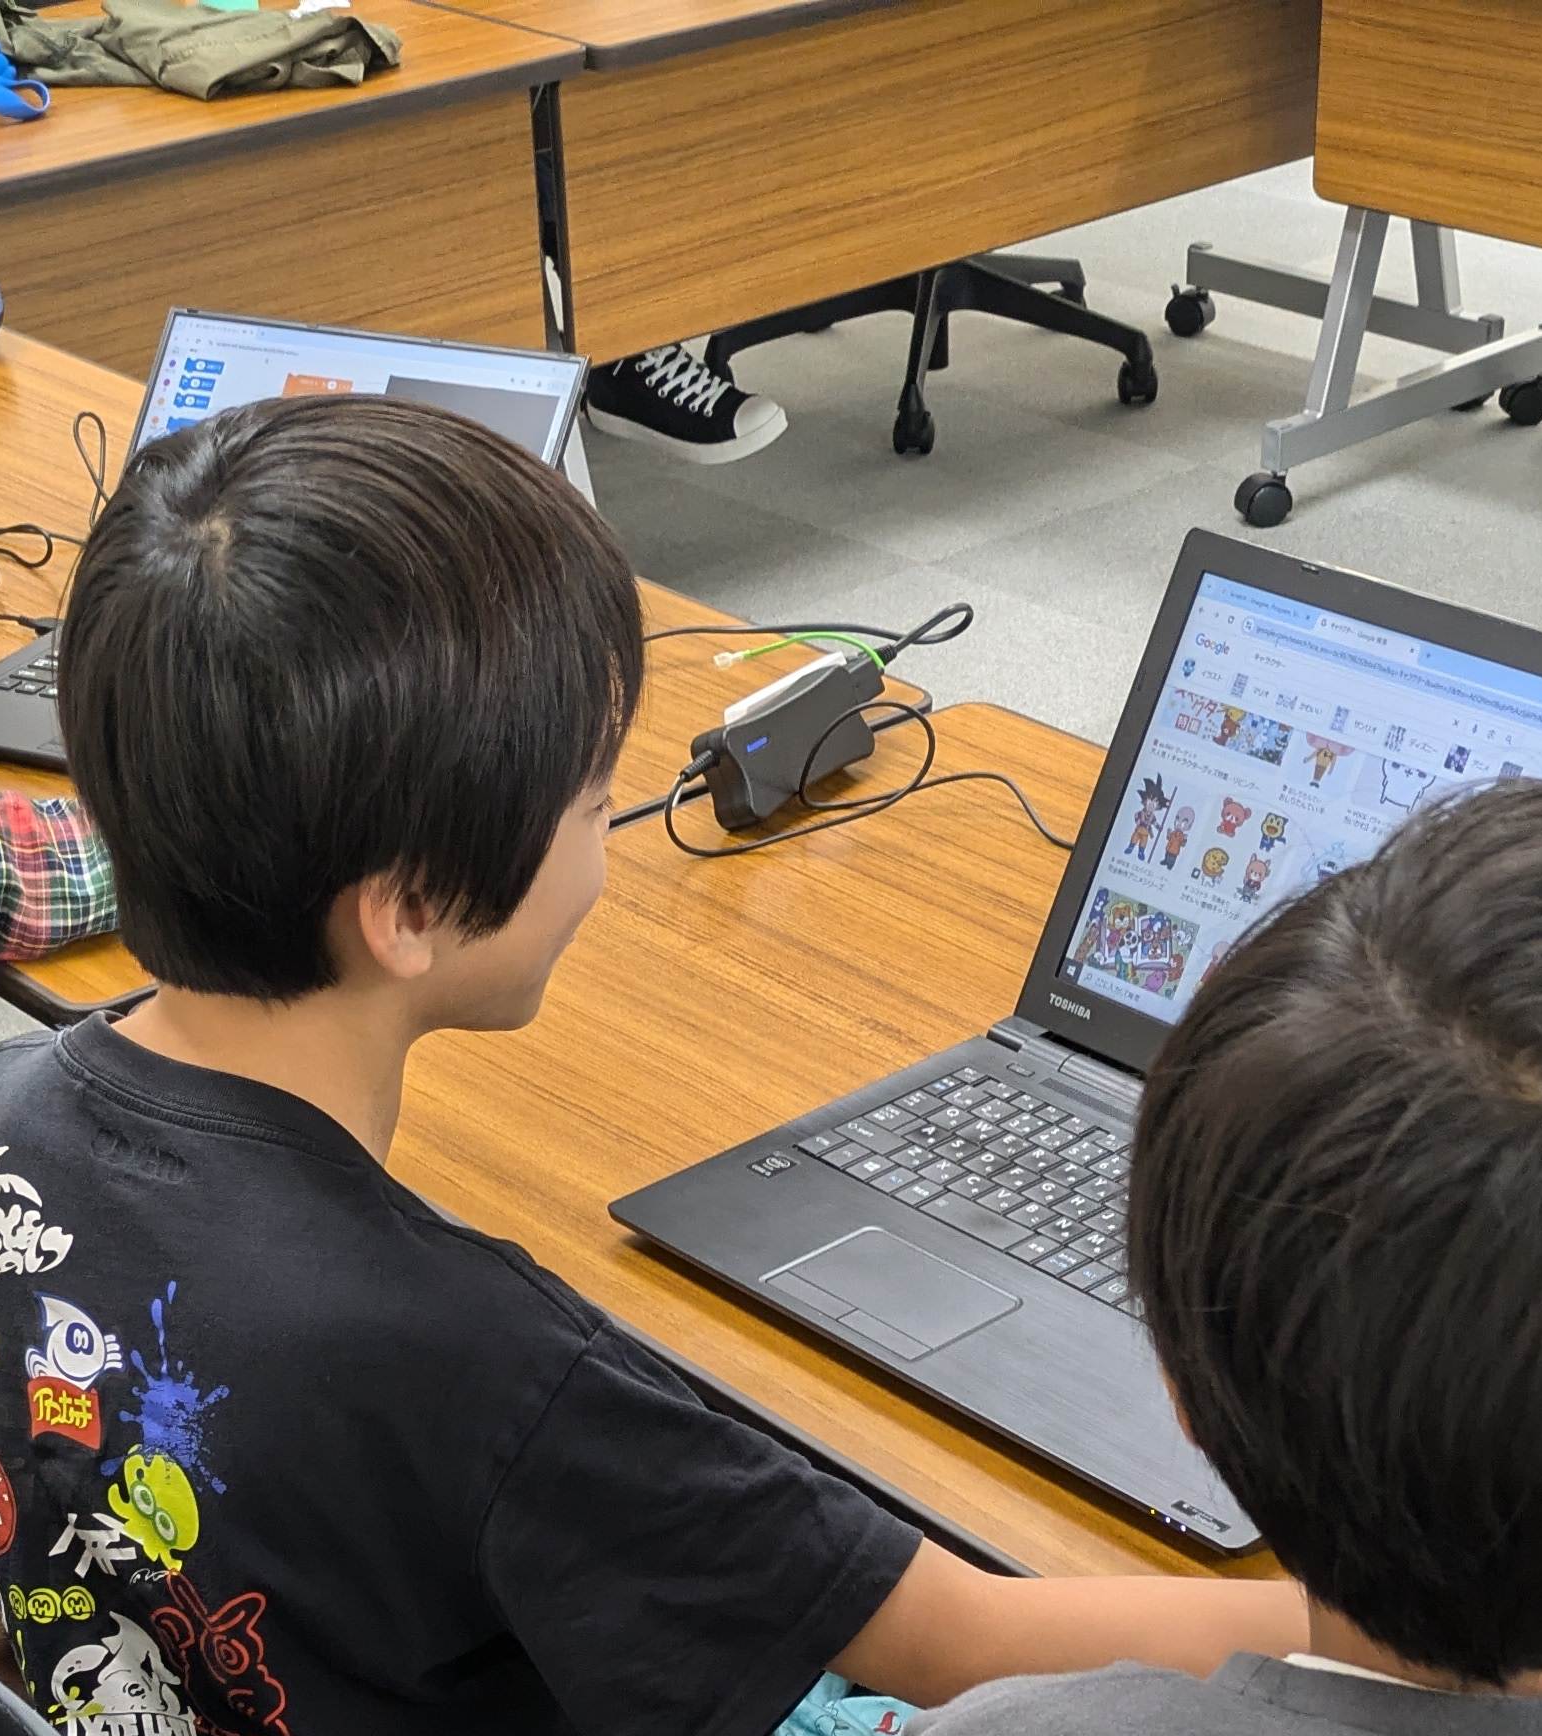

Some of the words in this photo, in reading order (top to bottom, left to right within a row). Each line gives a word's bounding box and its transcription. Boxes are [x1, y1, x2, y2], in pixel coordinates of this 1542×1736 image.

[1195, 632, 1230, 656] Google
[1048, 992, 1092, 1021] TOSHIBA
[946, 1107, 960, 1118] Q
[920, 1125, 936, 1136] A
[975, 1120, 993, 1132] W
[950, 1139, 965, 1149] S
[980, 1153, 995, 1163] D
[1009, 1166, 1025, 1177] F
[1063, 1163, 1079, 1174] T
[966, 1175, 982, 1186] C
[1041, 1181, 1057, 1193] G
[997, 1188, 1012, 1200] V
[1025, 1203, 1039, 1214] B
[1100, 1212, 1115, 1221] J
[1055, 1217, 1073, 1230] N
[1086, 1233, 1106, 1247] M
